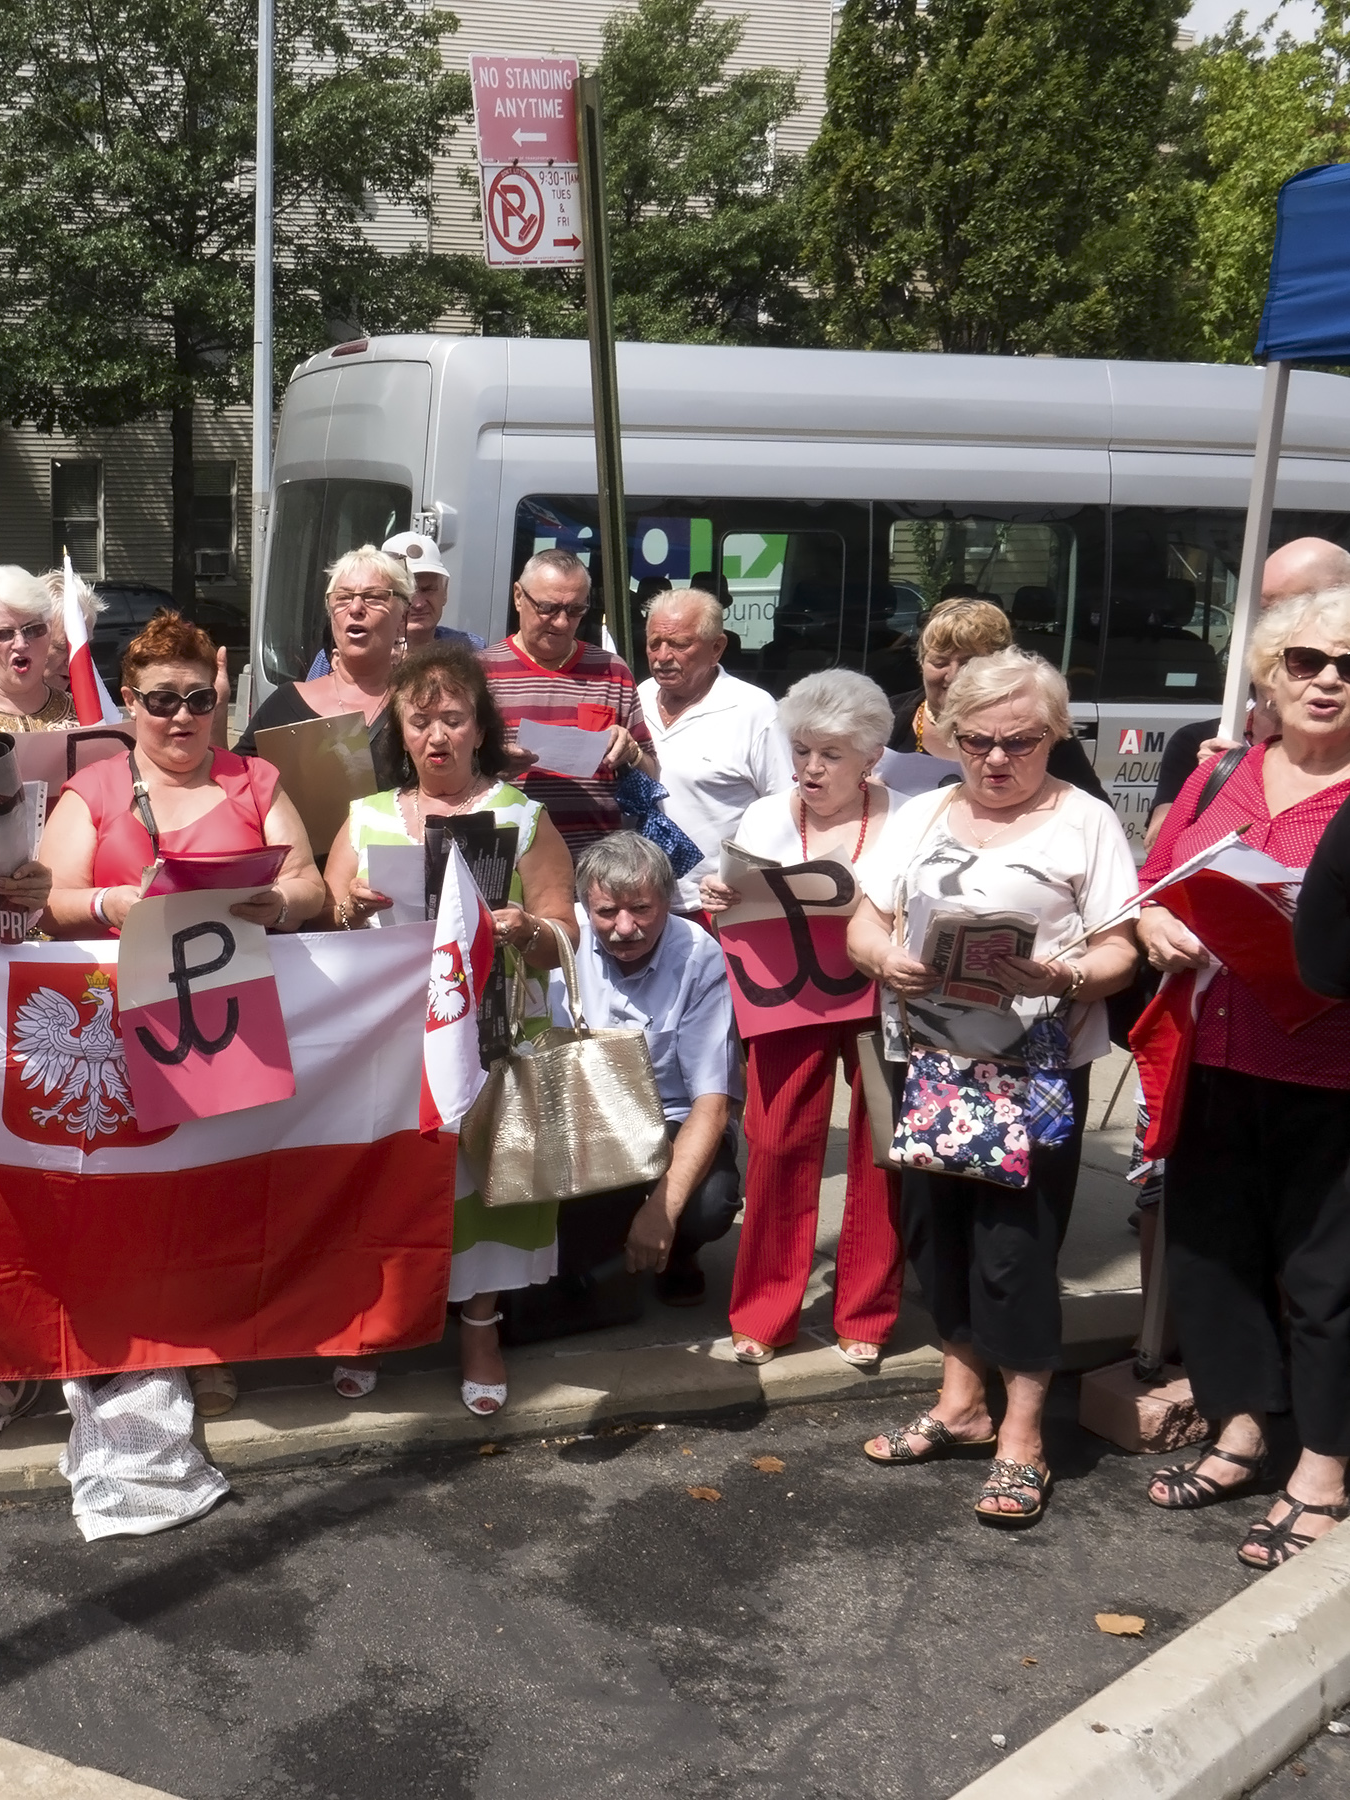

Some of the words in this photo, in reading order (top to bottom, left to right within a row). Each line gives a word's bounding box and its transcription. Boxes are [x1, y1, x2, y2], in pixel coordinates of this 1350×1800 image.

[479, 66, 499, 89] NO
[506, 67, 572, 90] STANDING
[494, 97, 564, 119] ANYTIME
[552, 189, 572, 200] TUES
[559, 203, 565, 213] &
[557, 217, 569, 227] FRI
[964, 940, 990, 971] OPEN
